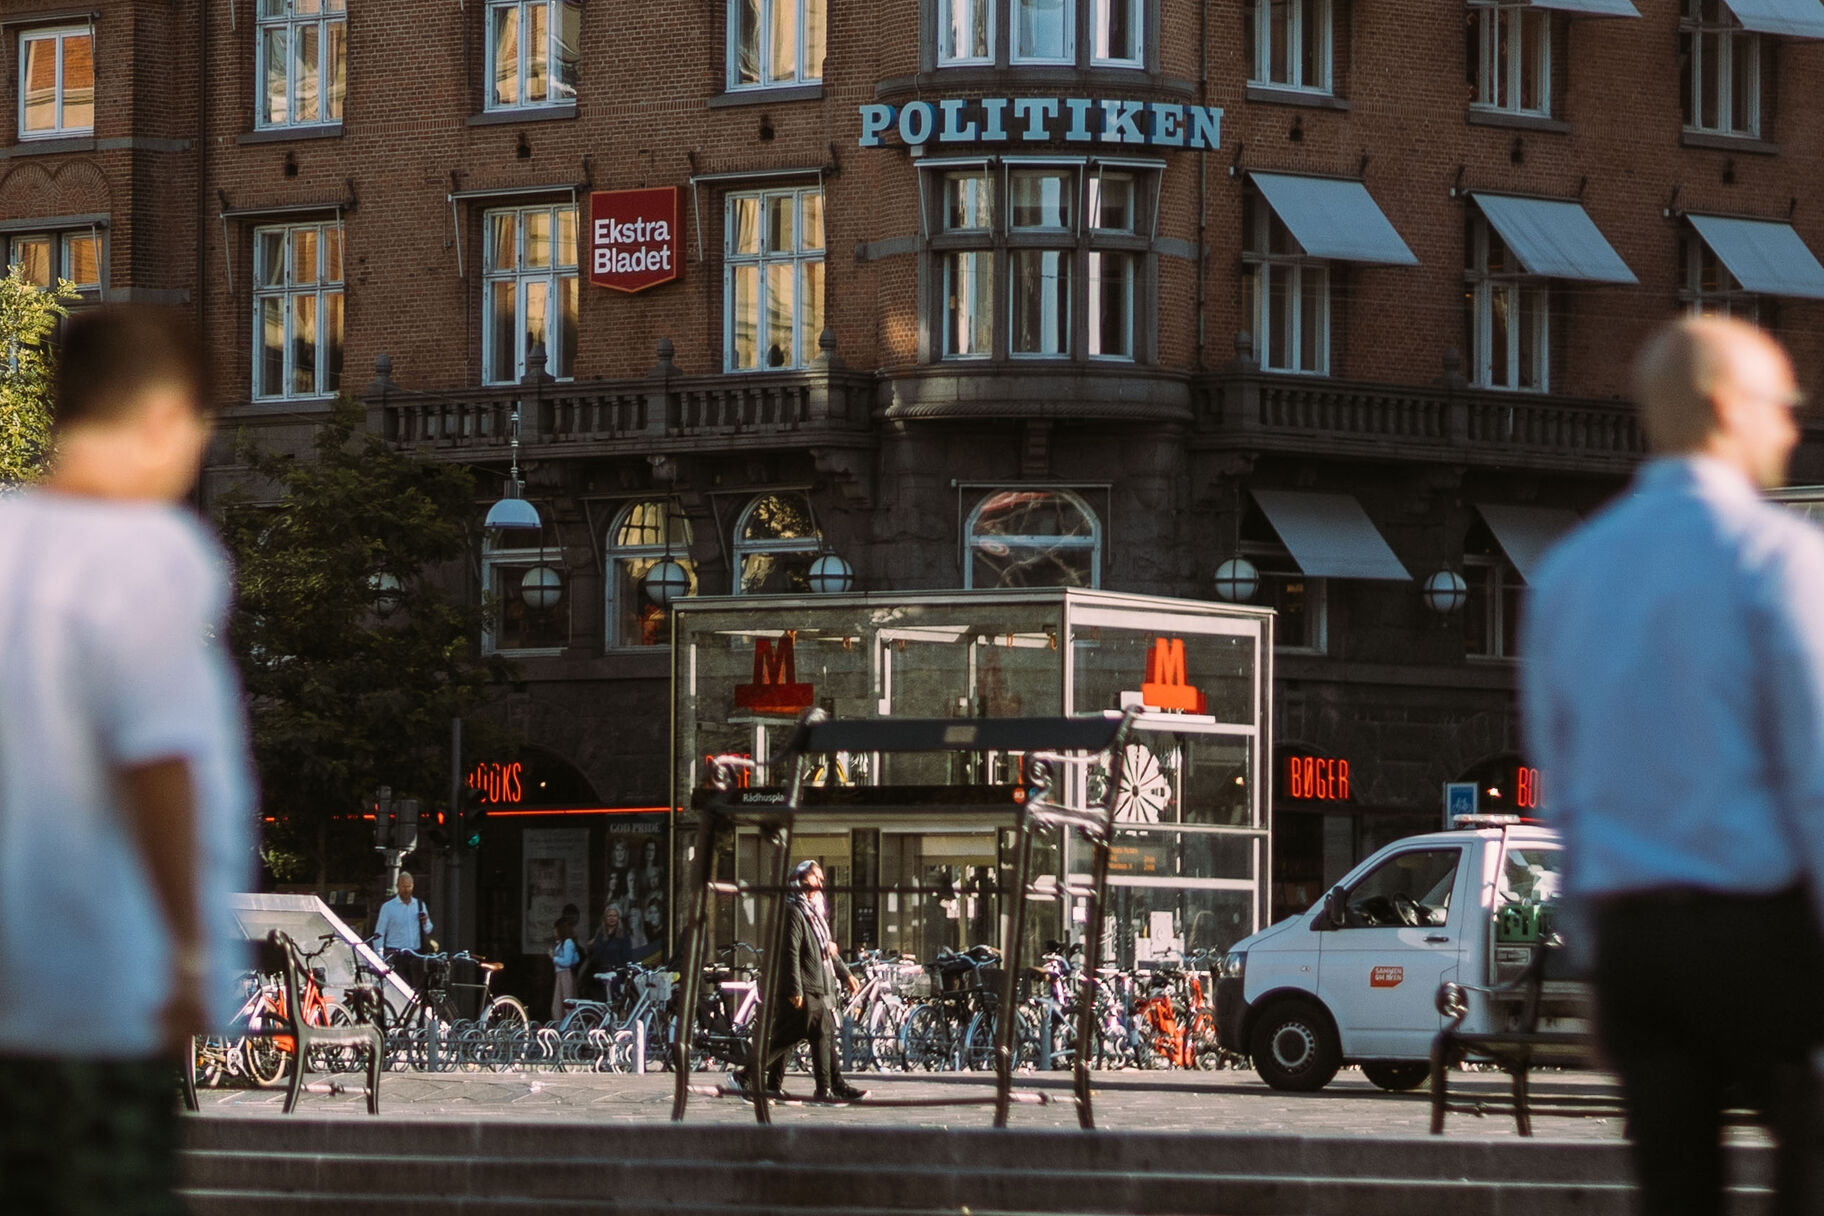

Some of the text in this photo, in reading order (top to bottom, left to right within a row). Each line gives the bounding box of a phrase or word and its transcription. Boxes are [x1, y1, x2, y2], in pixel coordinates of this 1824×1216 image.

[858, 97, 1224, 150] POLITIKEN
[594, 216, 671, 245] Ekstra
[594, 244, 671, 274] Bladet
[1291, 756, 1350, 800] BØGER
